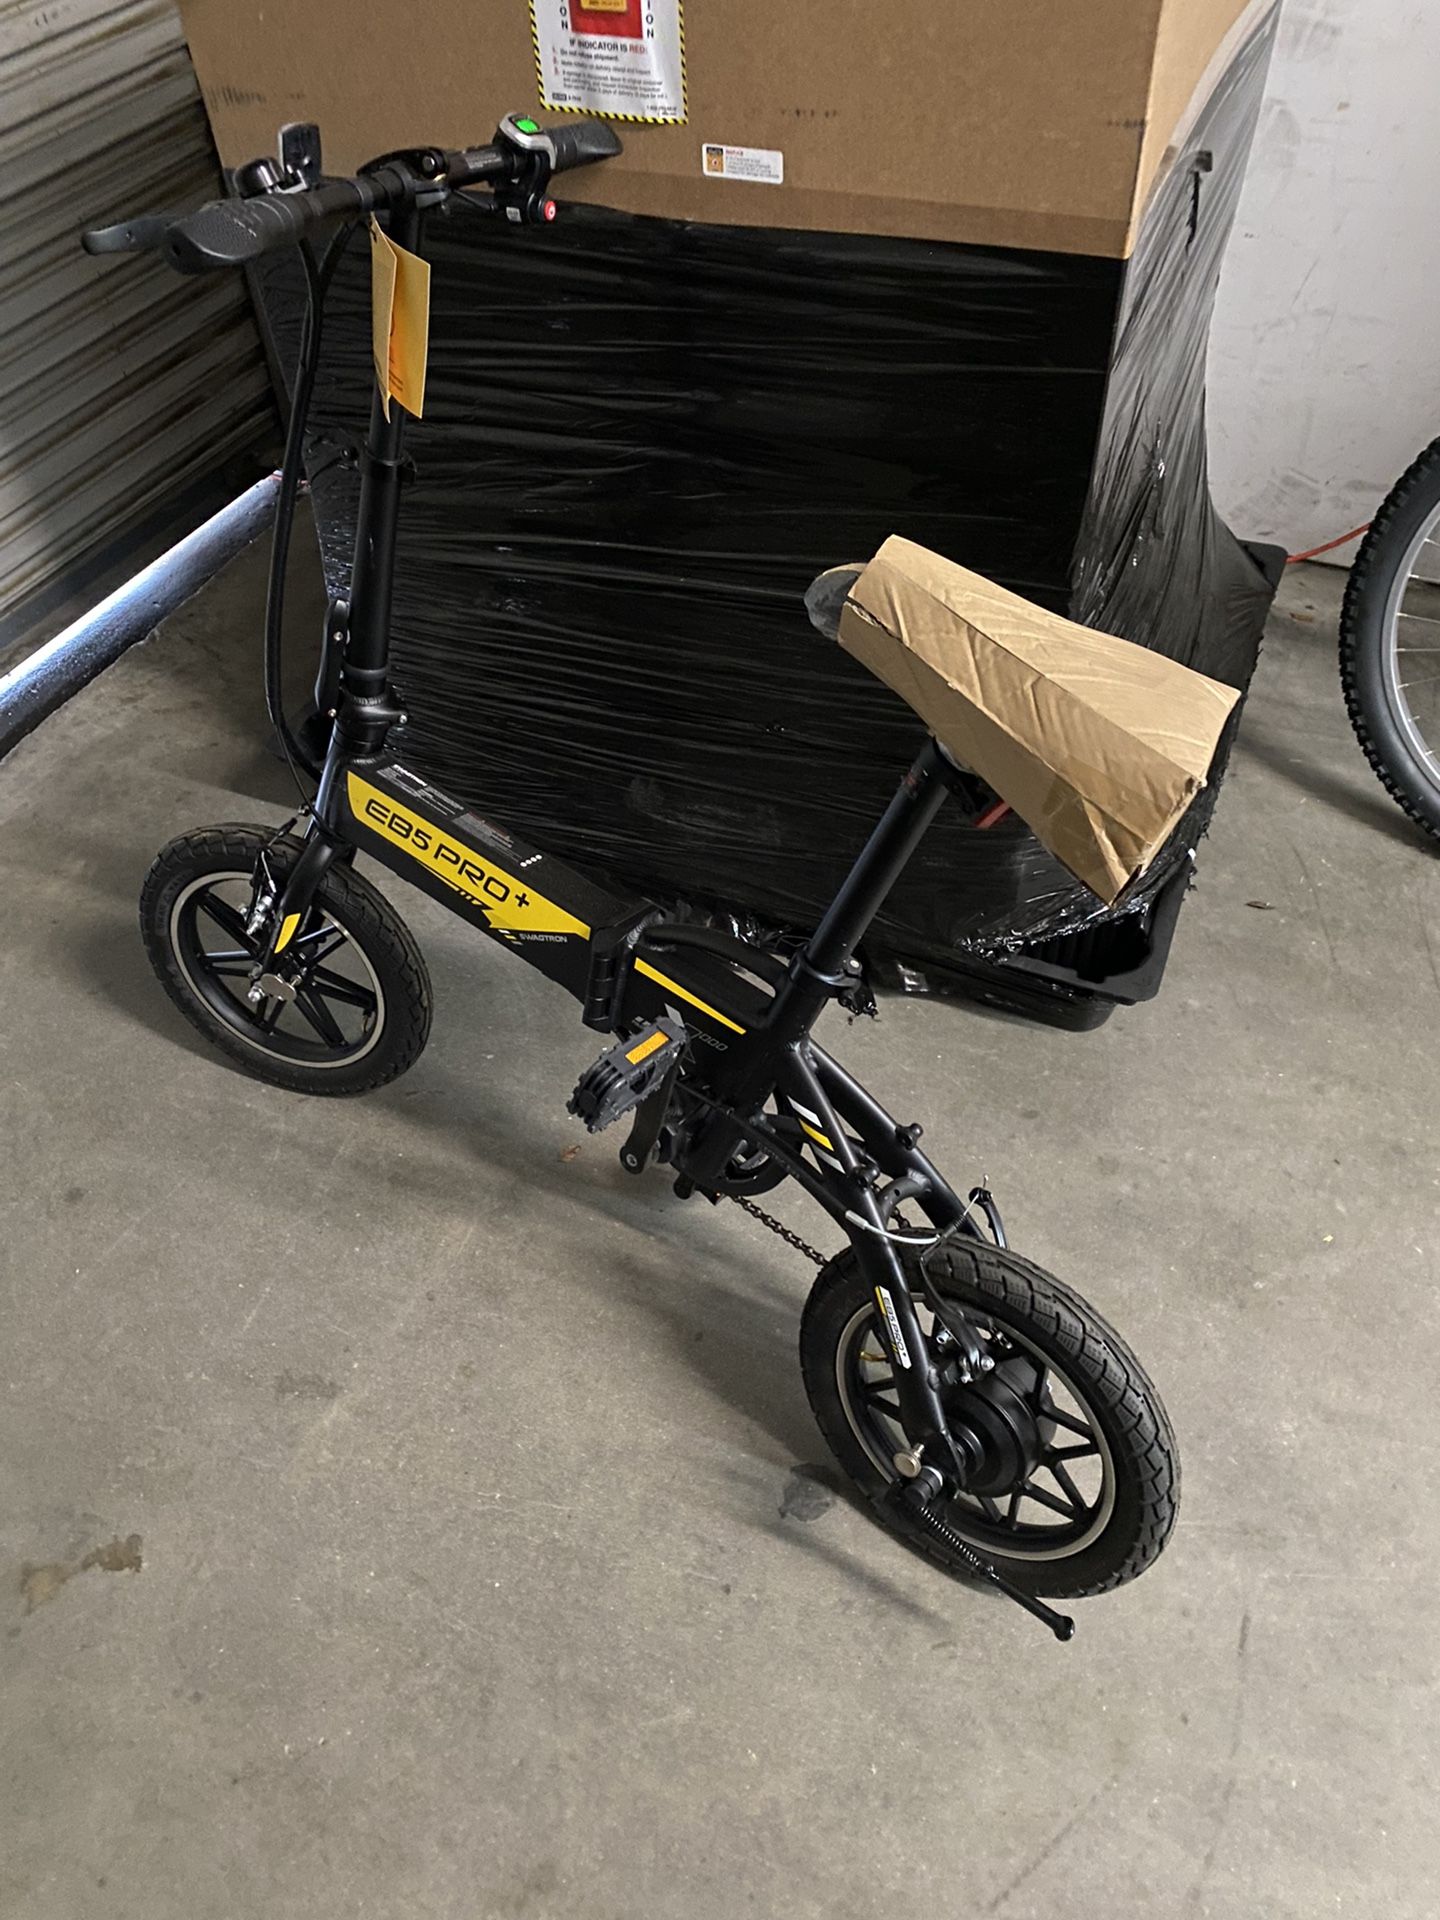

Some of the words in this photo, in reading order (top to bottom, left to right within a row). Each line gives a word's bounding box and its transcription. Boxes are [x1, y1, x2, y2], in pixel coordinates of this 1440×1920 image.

[577, 40, 618, 52] INDICATOR
[620, 43, 627, 52] IS
[365, 798, 432, 851] EB5
[519, 932, 568, 943] SWAGTRON
